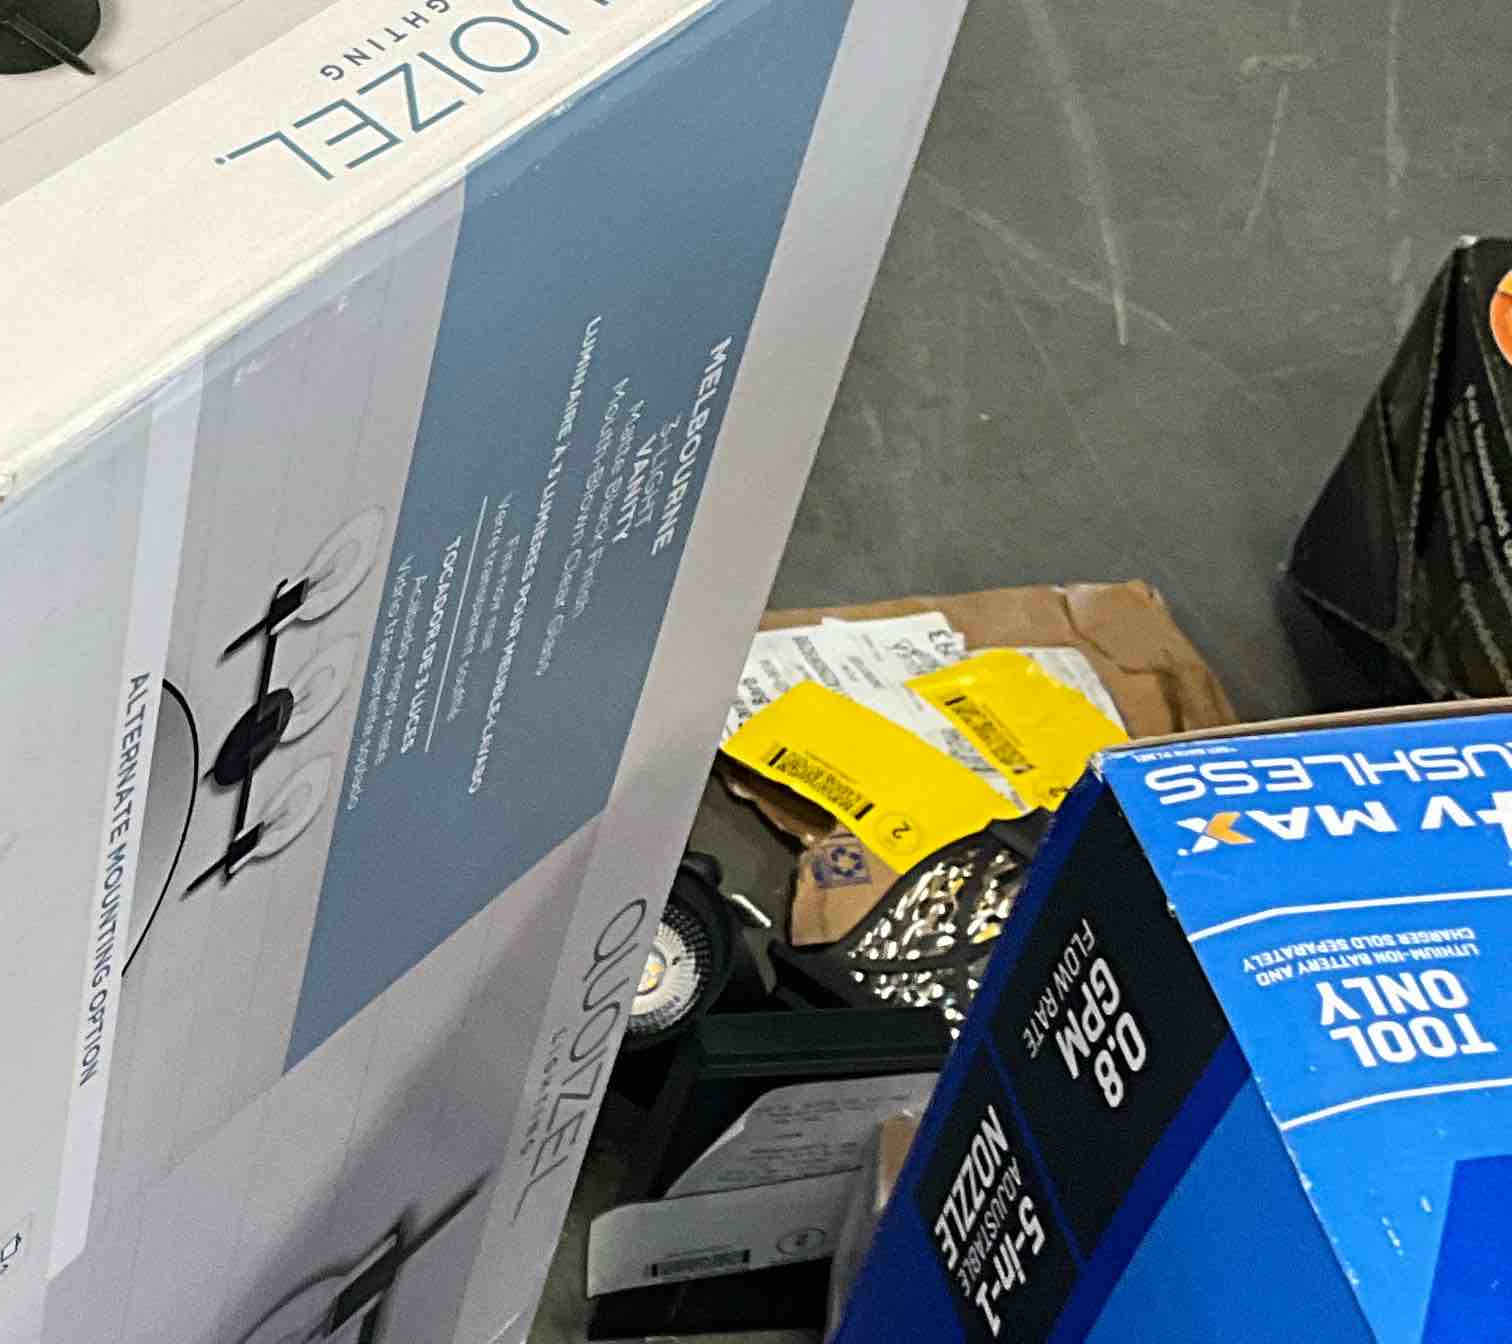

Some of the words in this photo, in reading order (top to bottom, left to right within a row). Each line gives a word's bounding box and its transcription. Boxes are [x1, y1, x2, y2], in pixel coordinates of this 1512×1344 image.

[557, 312, 602, 442] LUMINAIRE
[631, 411, 683, 535] 3-LIGHT
[648, 334, 732, 560] MELBOURNE
[608, 433, 656, 551] VANITY
[424, 535, 461, 645] TOCADOR
[506, 580, 533, 641] POUR
[413, 671, 430, 691] 3
[417, 640, 437, 675] DE
[109, 665, 150, 845] ALTERNATE
[399, 687, 426, 756] LUCES
[466, 637, 518, 799] MEUBLE-LAVABO
[1177, 802, 1395, 856] MAX
[91, 840, 127, 990] MOUNTING
[1242, 937, 1347, 972] SEPARATELY
[1350, 933, 1394, 951] SOLD
[1372, 943, 1479, 965] LITHIUM-ION
[1397, 926, 1475, 947] CHARGER
[1046, 918, 1095, 999] FLOW
[1256, 967, 1291, 987] AND
[1297, 951, 1370, 974] BATTERY
[1314, 968, 1468, 1026] ONLY
[79, 984, 108, 1088] OPTION
[1020, 988, 1065, 1059] RATE
[1055, 957, 1121, 1080] GPM
[1330, 1012, 1498, 1069] TOOL
[511, 898, 647, 1223] QUOIZEL
[1093, 1011, 1147, 1108] 0.8
[933, 1104, 1008, 1272] NOZZLE
[958, 1158, 1022, 1296] ADJUSTABLE
